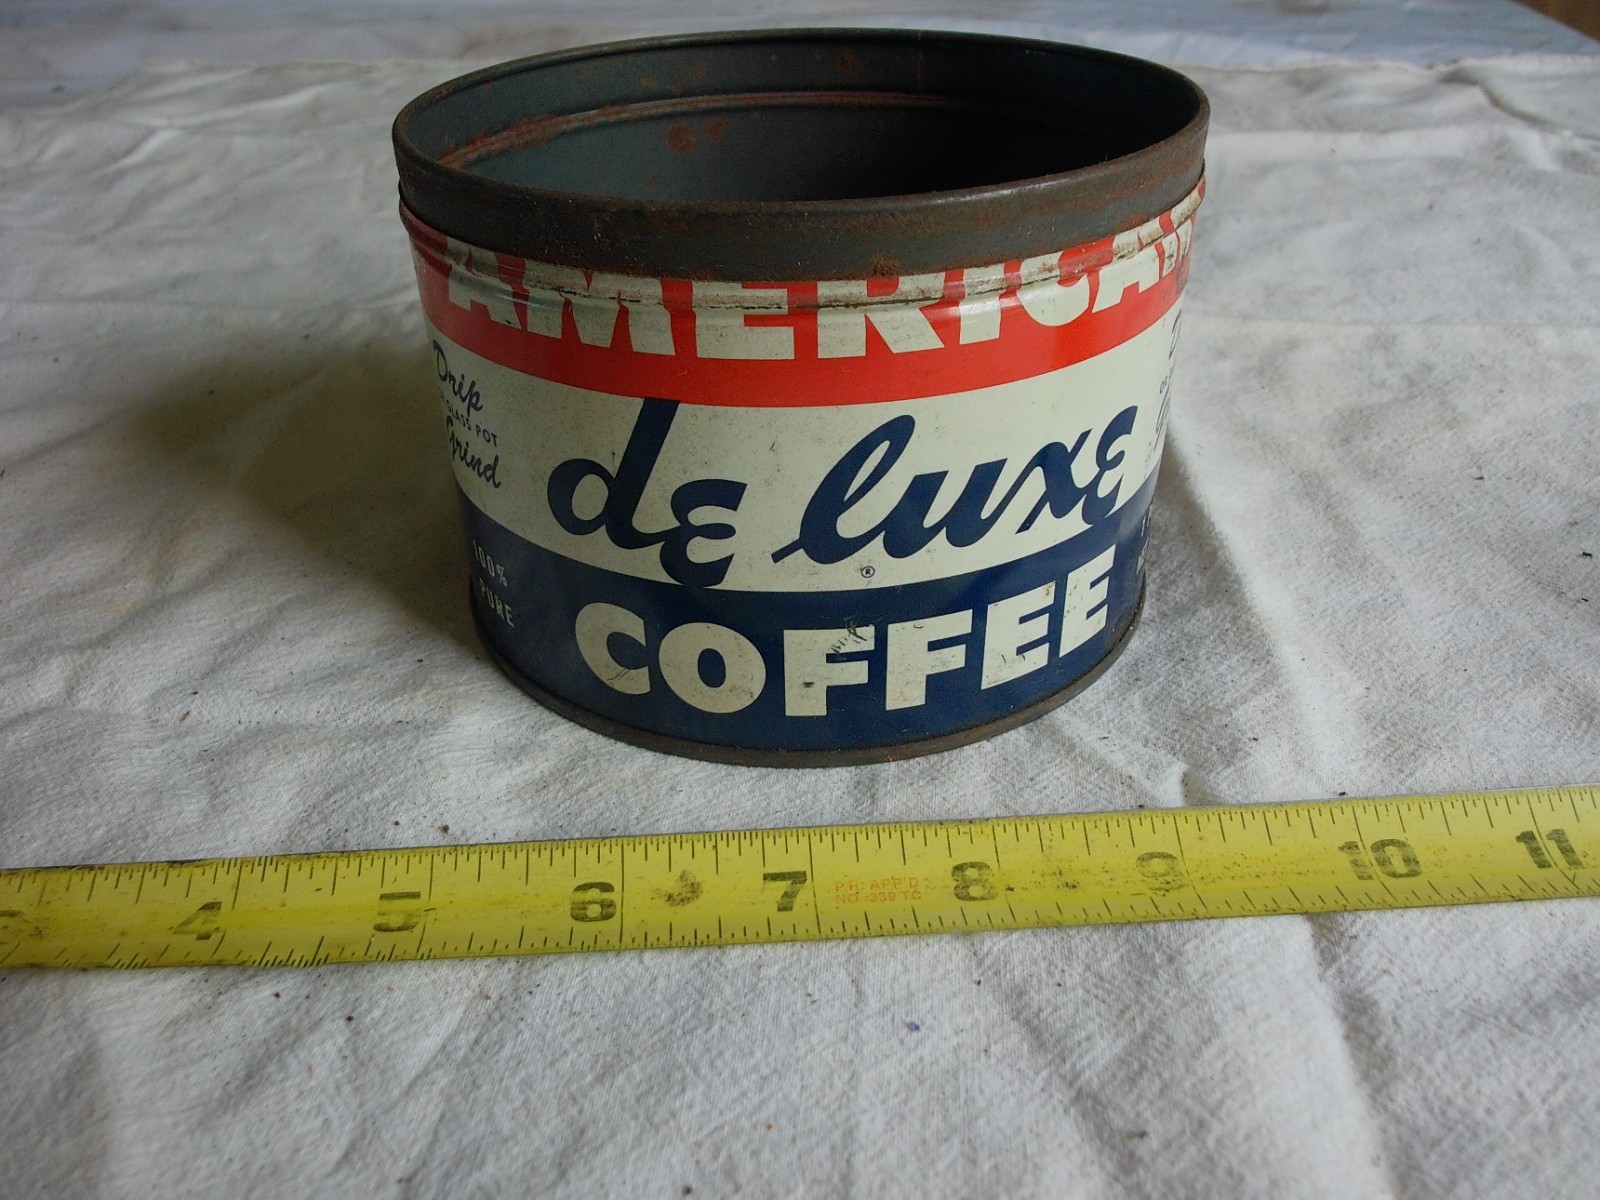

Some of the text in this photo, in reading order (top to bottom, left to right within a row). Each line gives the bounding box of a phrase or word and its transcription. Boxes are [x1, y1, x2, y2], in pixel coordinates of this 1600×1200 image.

[433, 340, 483, 416] Drip
[475, 424, 497, 447] POT
[547, 397, 1138, 588] de luxe
[473, 540, 508, 587] 100%
[480, 577, 515, 628] PURE
[575, 544, 1116, 716] COFFEE
[172, 828, 1583, 940] 4 5 6 7 8 9 10 11
